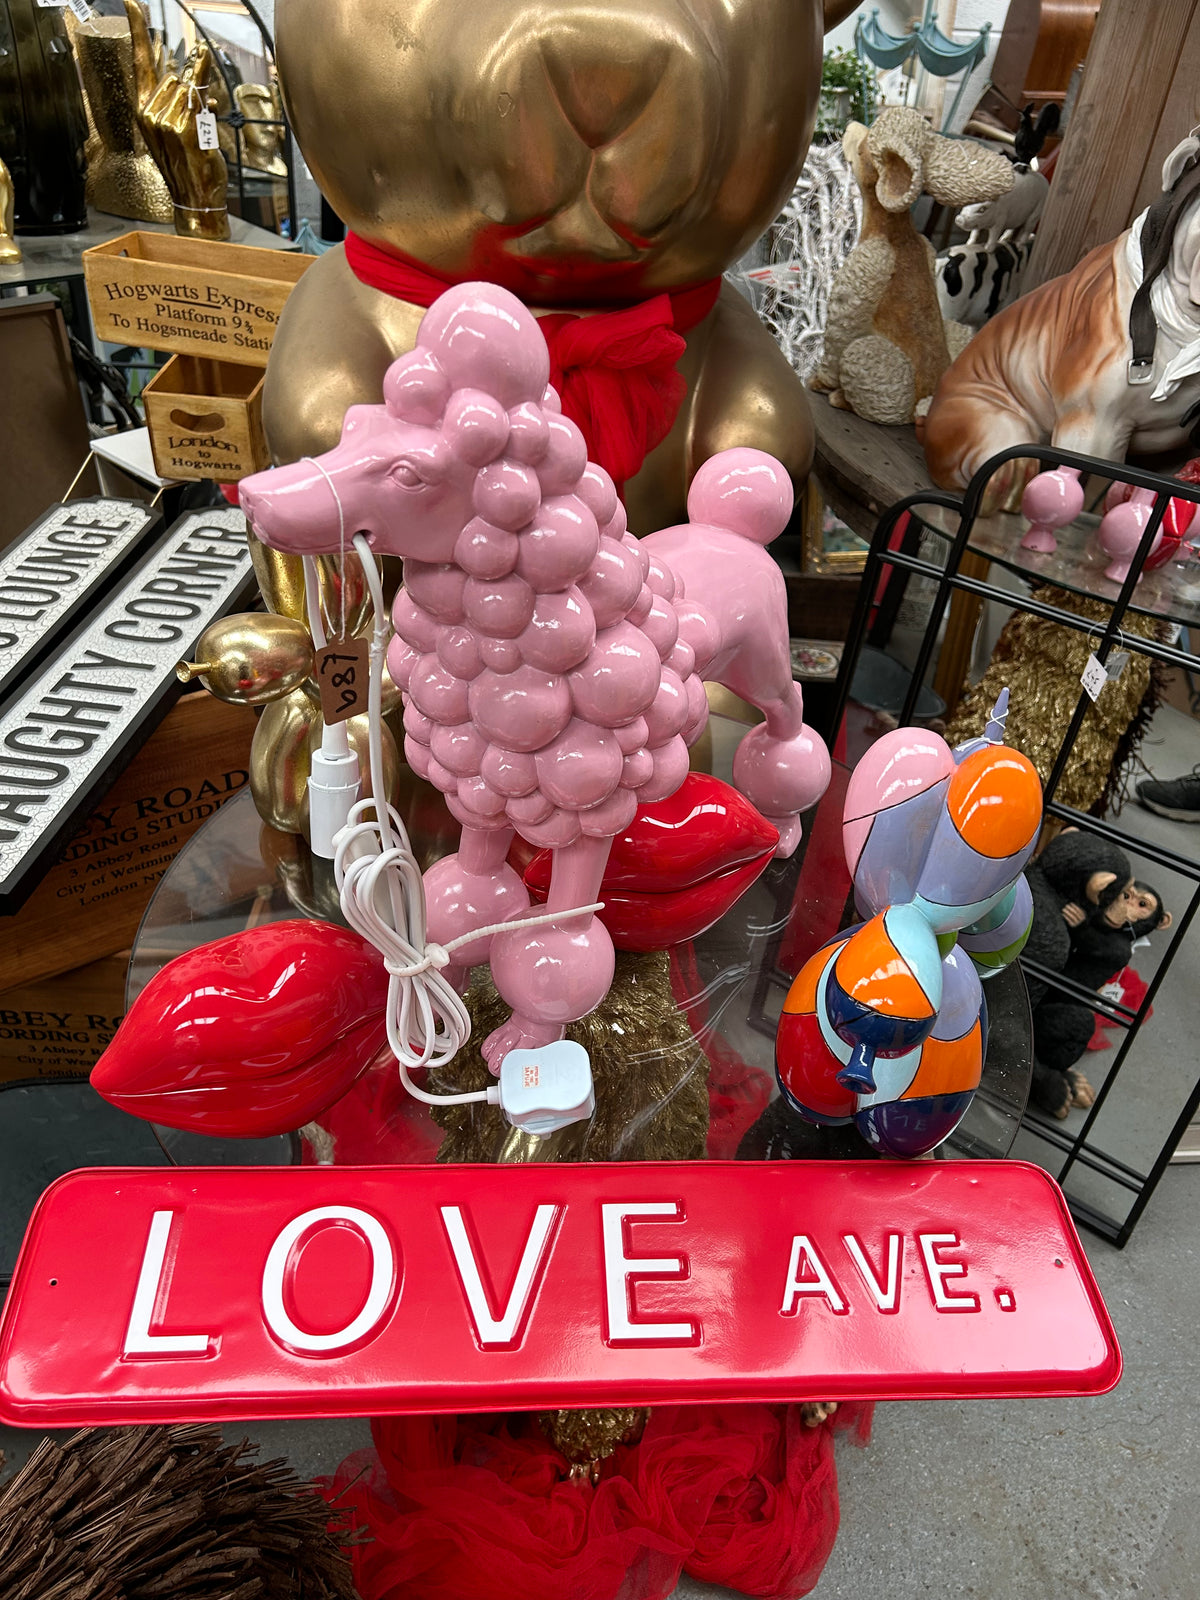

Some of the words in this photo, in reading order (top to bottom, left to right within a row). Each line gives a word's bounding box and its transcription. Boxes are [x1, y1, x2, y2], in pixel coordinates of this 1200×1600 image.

[104, 282, 199, 301] Hogwarts
[109, 312, 130, 328] To
[137, 317, 228, 344] Hogsmeade
[234, 332, 273, 351] Stati
[154, 303, 226, 327] Platform
[168, 436, 239, 454] London
[198, 450, 211, 458] to
[172, 458, 242, 470] Hogwarts
[0, 650, 156, 842] AUGHTY
[104, 526, 248, 643] CORNER
[321, 653, 358, 713] £89
[134, 769, 249, 820] ROAD
[147, 794, 234, 836] STUDI
[69, 868, 79, 879] 3
[85, 851, 134, 873] Abbey
[139, 836, 178, 854] Road
[56, 882, 88, 898] City
[92, 875, 106, 887] of
[79, 880, 138, 907] London
[122, 1203, 693, 1353] LOVE
[780, 1234, 1012, 1312] AVE.
